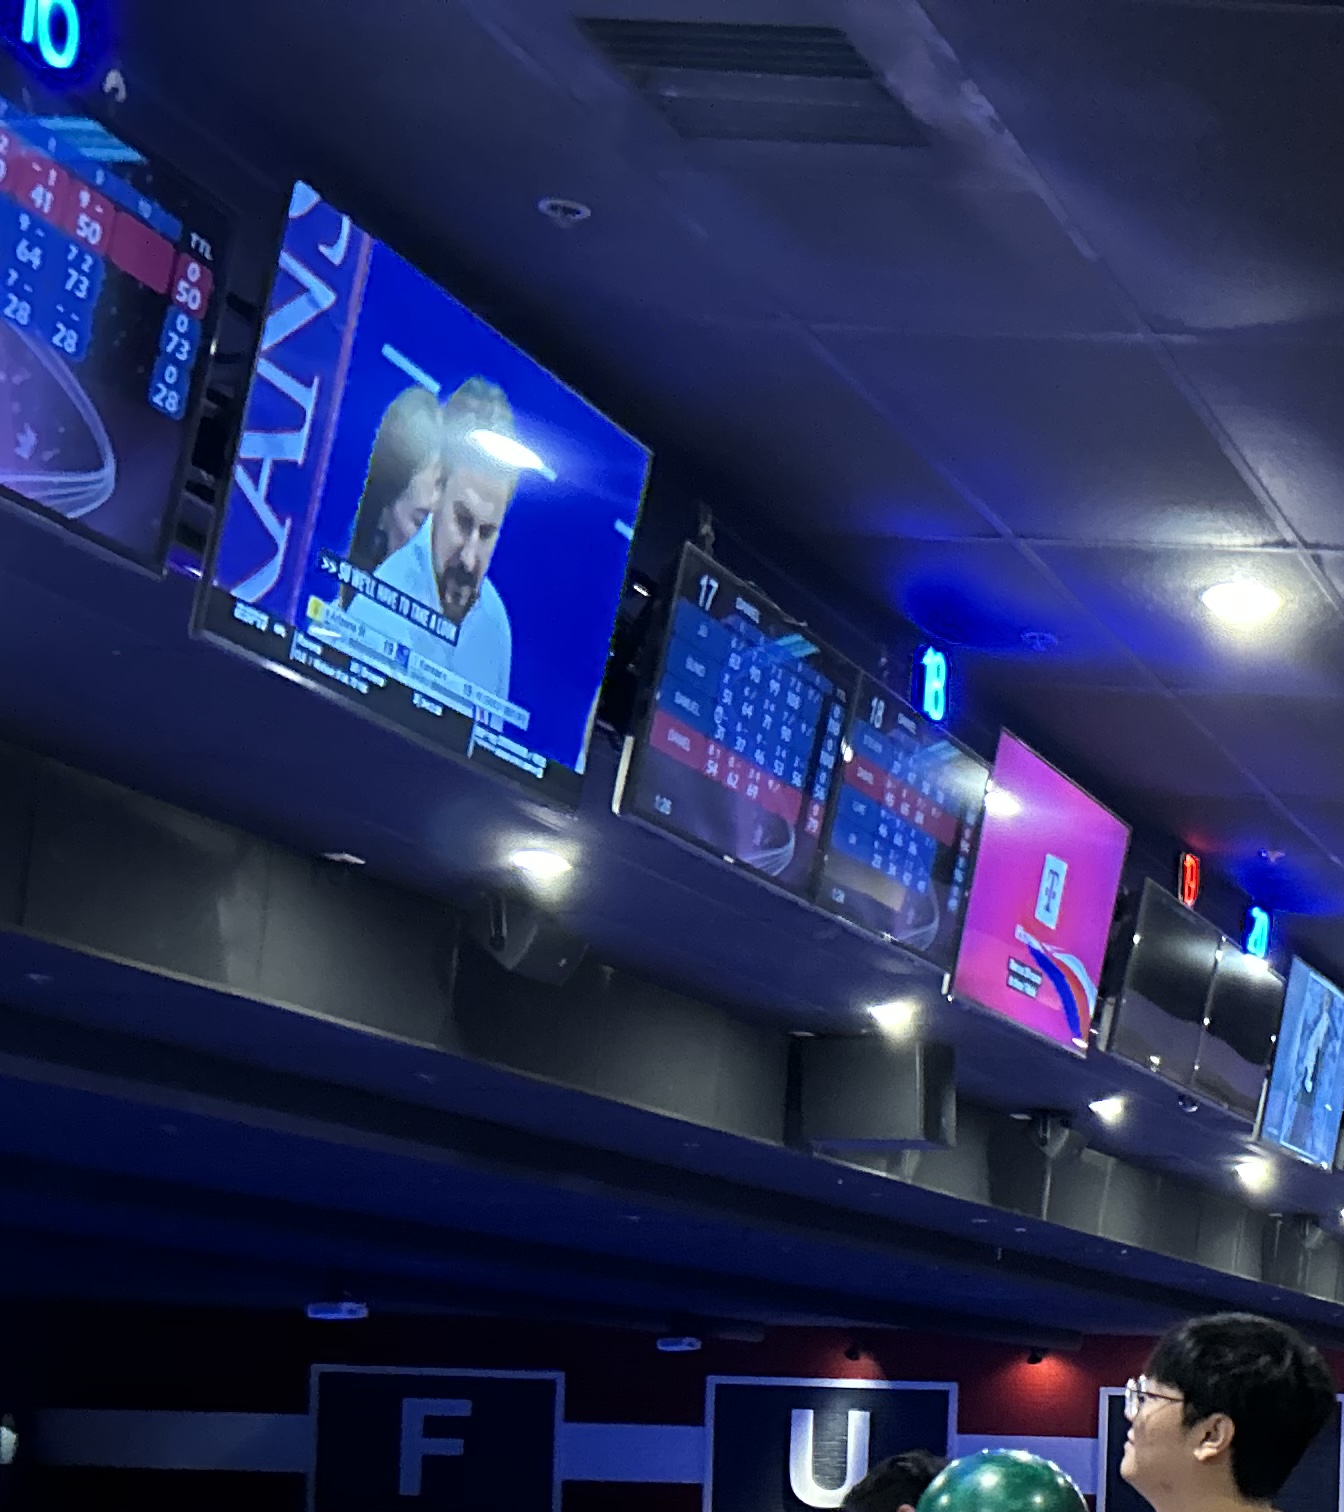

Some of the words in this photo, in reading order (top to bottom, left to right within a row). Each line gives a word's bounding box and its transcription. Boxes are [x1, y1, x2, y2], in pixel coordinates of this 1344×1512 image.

[76, 213, 102, 245] 50
[16, 238, 43, 270] 64
[65, 267, 89, 299] 73
[176, 279, 201, 310] 50
[3, 293, 31, 325] 28
[52, 322, 78, 354] 28
[166, 332, 190, 361] 73
[152, 383, 179, 412] 28
[699, 575, 719, 611] 17
[399, 1399, 472, 1496] F
[790, 1409, 870, 1508] U
